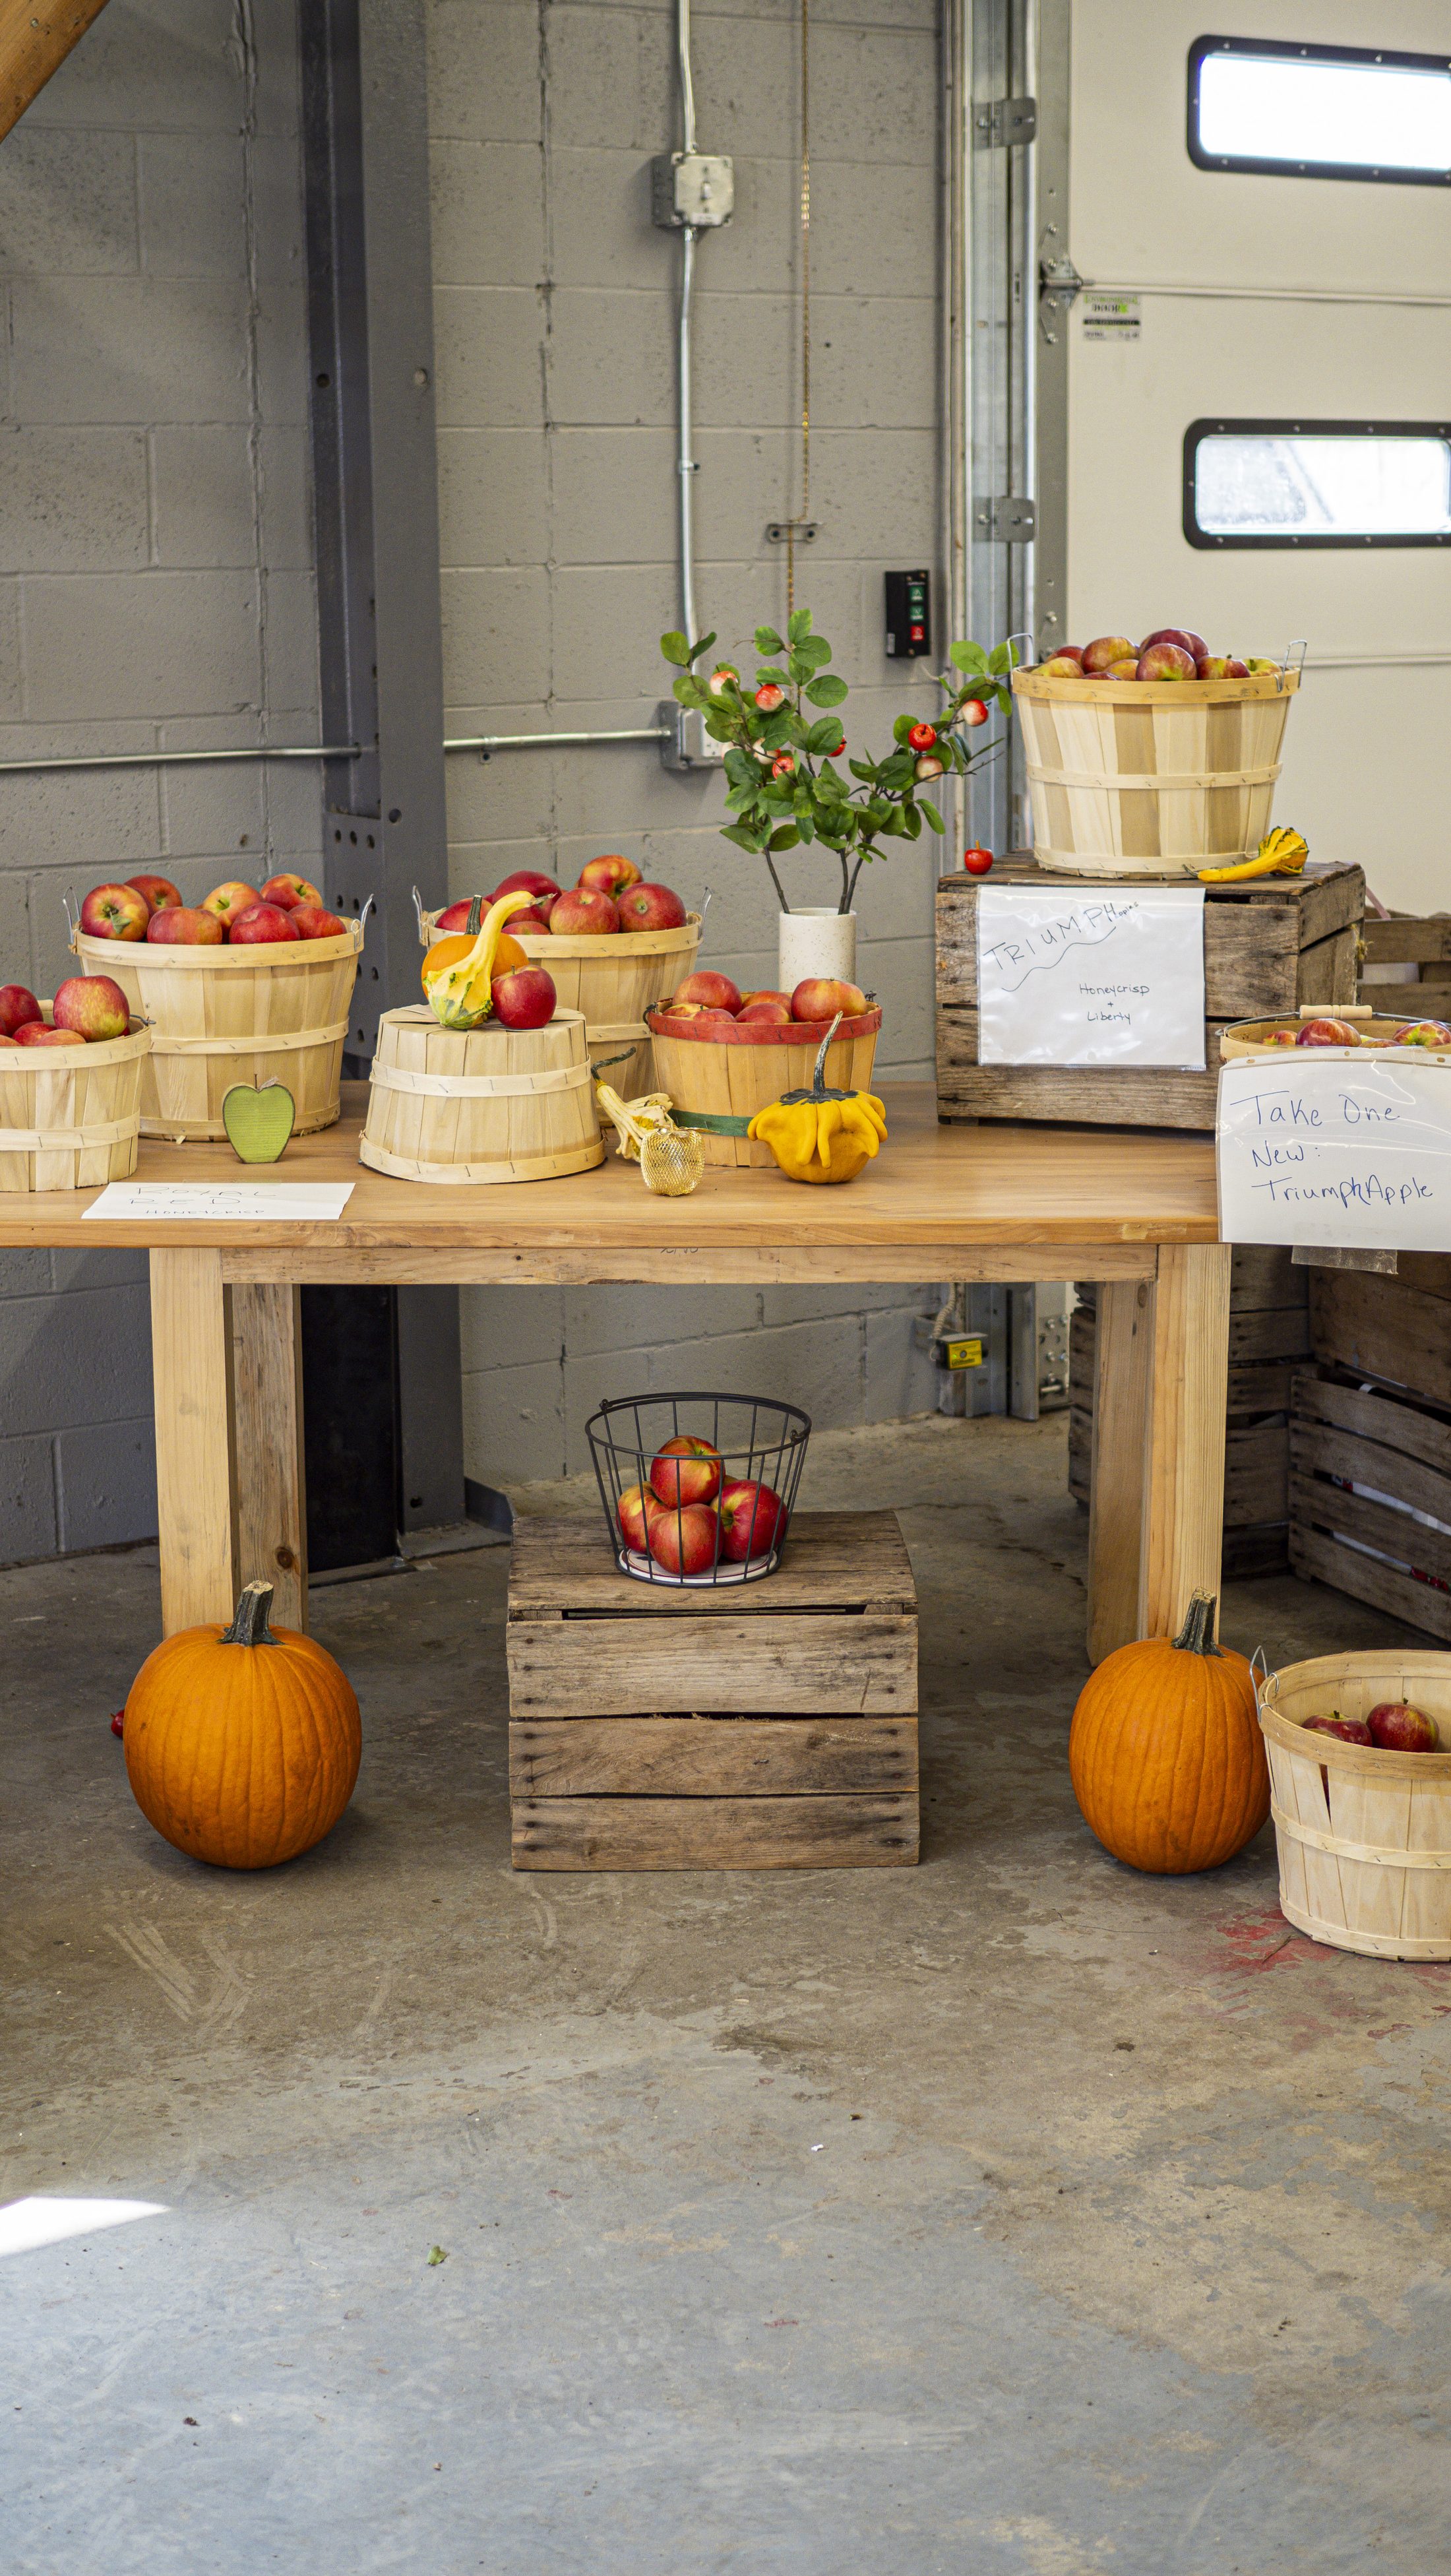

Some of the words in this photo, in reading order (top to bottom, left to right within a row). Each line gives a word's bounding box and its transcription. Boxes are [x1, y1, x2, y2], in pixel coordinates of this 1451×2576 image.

[983, 902, 1116, 970] TRIUMPH
[1078, 984, 1150, 997] Honeycrisp
[1087, 1011, 1132, 1024] Liberty
[1229, 1090, 1323, 1127] Take
[1338, 1094, 1401, 1124] One
[136, 1186, 276, 1197] ROYAL
[129, 1196, 241, 1205] RED
